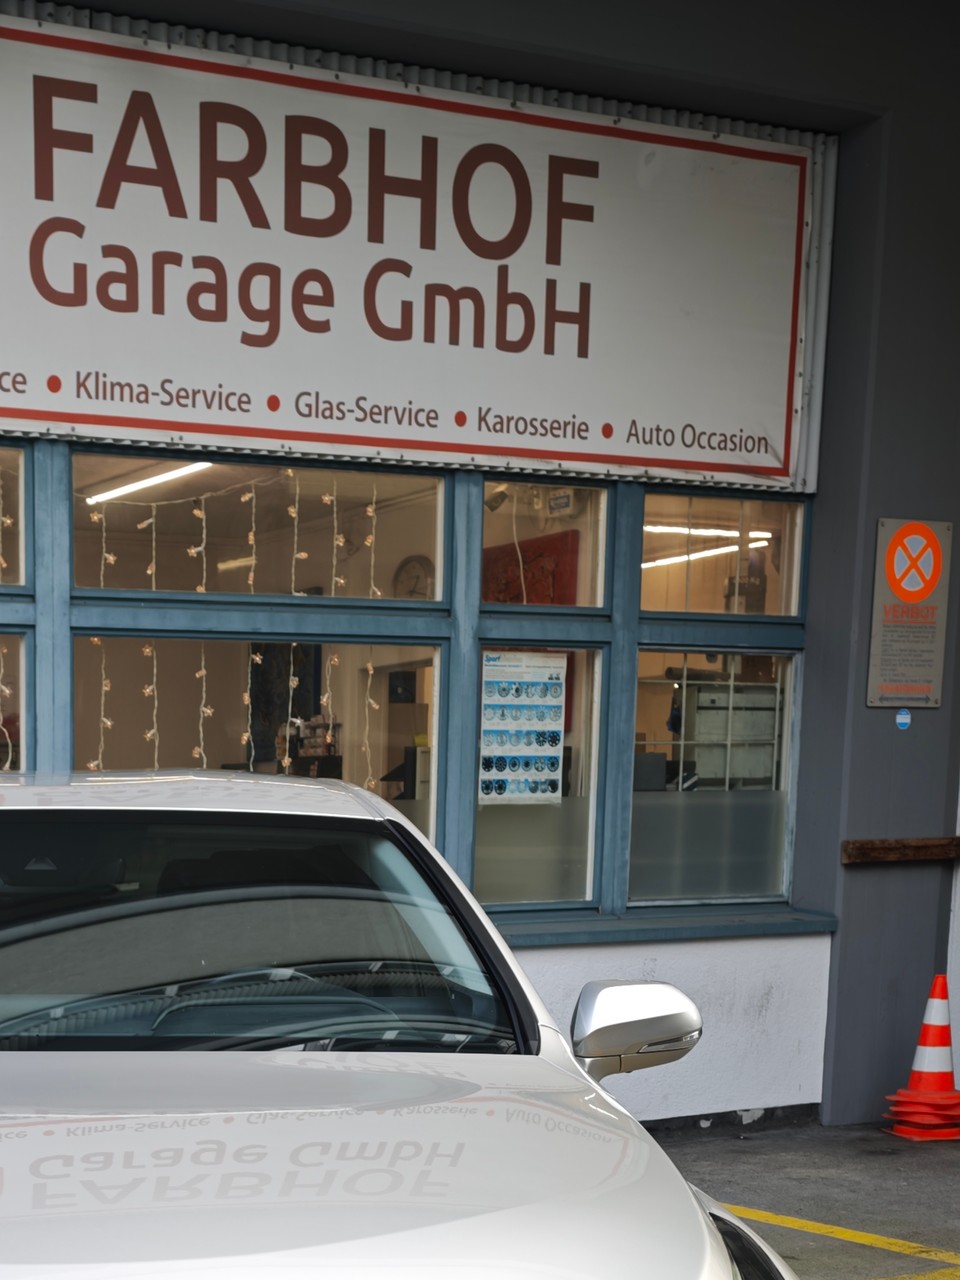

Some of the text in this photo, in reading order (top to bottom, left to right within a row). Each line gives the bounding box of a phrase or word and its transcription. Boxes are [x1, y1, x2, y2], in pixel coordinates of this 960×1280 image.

[32, 74, 600, 266] FARBHOF
[28, 216, 592, 359] Garage GmbH
[75, 370, 253, 413] Klima-Service
[294, 391, 440, 429] Glas-Service
[476, 407, 590, 441] Karosserie
[625, 419, 676, 449] Auto
[680, 423, 770, 456] Occasion
